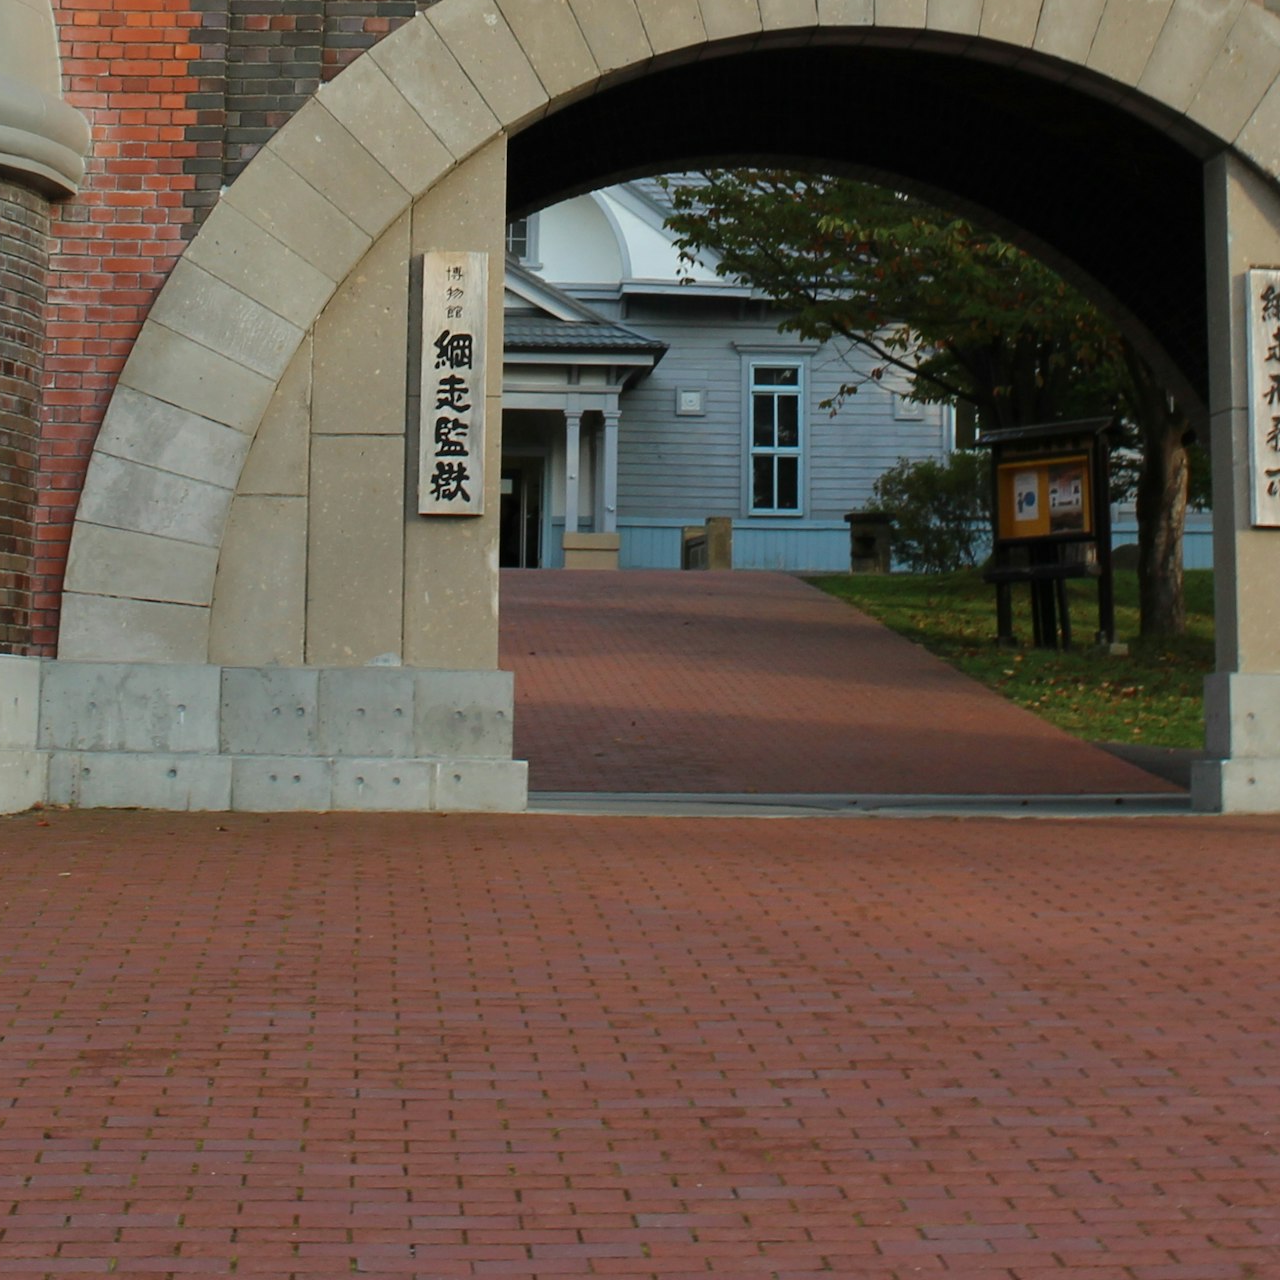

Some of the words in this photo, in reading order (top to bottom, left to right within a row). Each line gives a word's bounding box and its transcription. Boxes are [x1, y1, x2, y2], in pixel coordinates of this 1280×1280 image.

[445, 265, 465, 319] 博物館
[429, 329, 473, 503] 網走監獄
